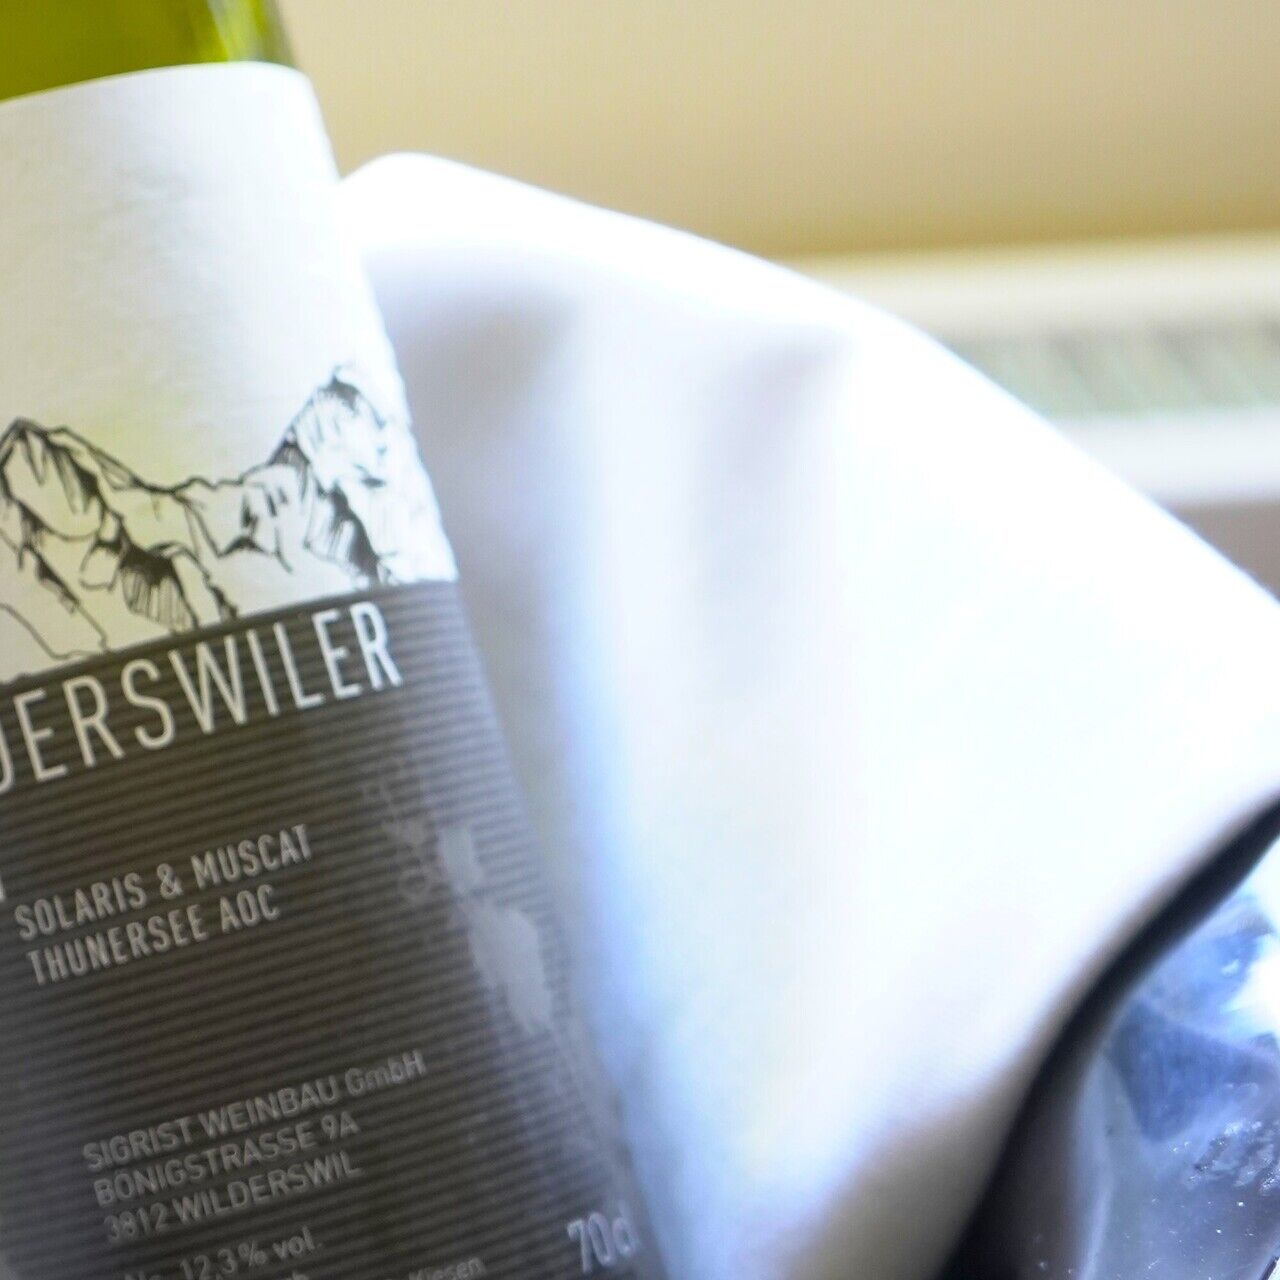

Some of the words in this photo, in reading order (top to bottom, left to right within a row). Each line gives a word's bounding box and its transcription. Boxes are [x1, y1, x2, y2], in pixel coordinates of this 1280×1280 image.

[15, 873, 148, 941] SOLARIS
[156, 863, 184, 900] &
[190, 823, 313, 890] MUSCAT
[27, 904, 209, 986] THUNERSEE
[220, 884, 281, 934] AOC
[83, 1116, 194, 1169] SIGRIST
[197, 1075, 342, 1139] WEINBAU
[345, 1050, 427, 1097] GmbH
[321, 1110, 362, 1141] 9A
[104, 1202, 169, 1244] 3812
[172, 1150, 363, 1225] WILDERSWIL
